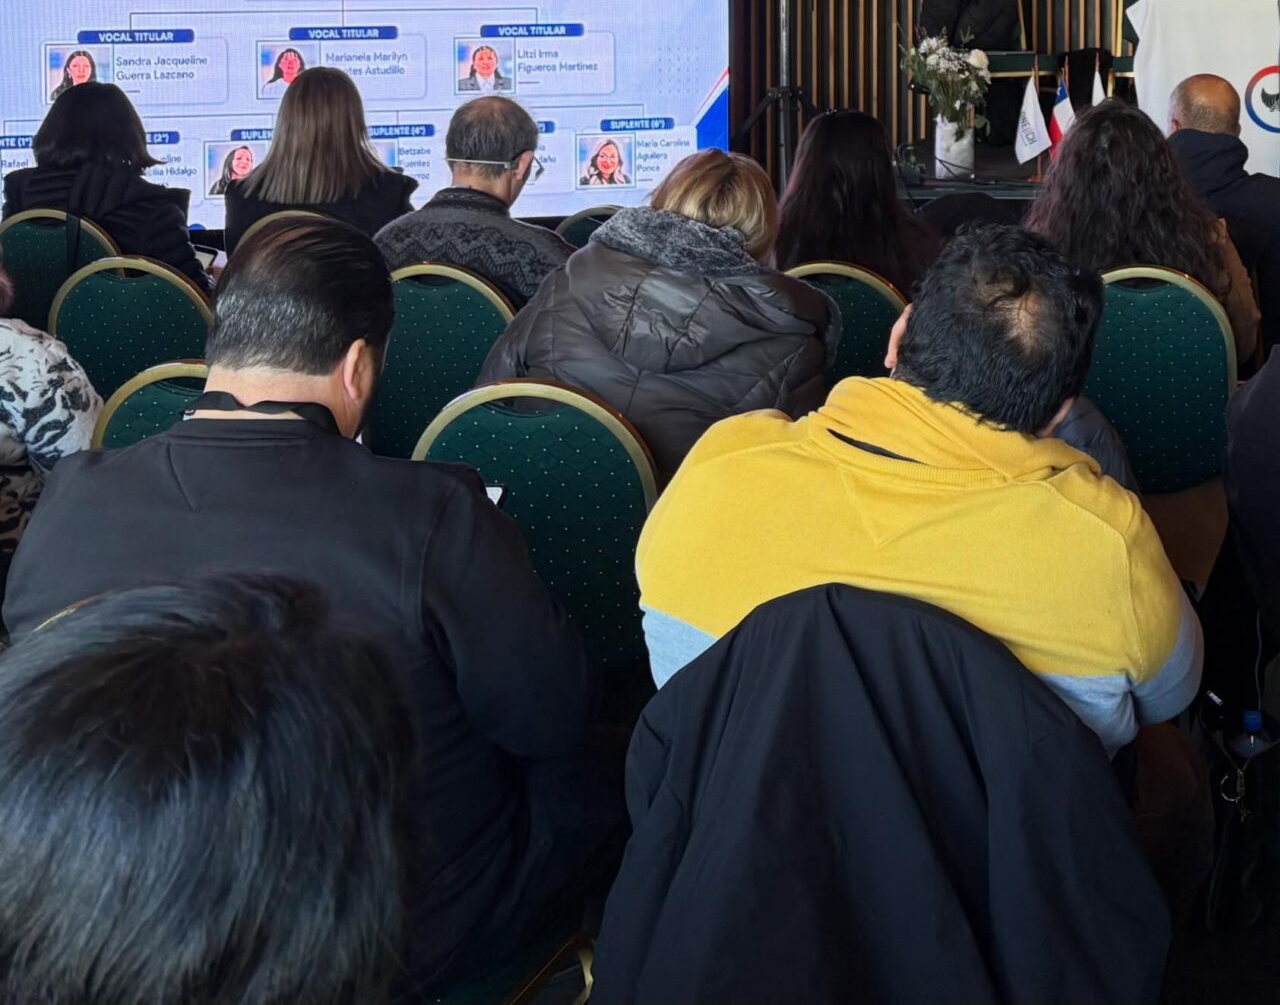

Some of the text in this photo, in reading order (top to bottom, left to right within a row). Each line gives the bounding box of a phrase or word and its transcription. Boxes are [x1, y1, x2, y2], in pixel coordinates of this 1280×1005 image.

[98, 31, 174, 42] VOCAL TITULAR
[308, 28, 379, 39] VOCAL TITULAR
[498, 26, 566, 36] VOCAL TITULAR
[116, 55, 208, 68] Sandra Jacqueline
[326, 51, 408, 64] Marianela Marilyn
[116, 70, 195, 81] Guerra Lazcano
[365, 65, 405, 76] Astudillo
[610, 120, 650, 130] SUPLENTE
[660, 138, 690, 147] Carolina
[166, 166, 198, 177] Hidalgo
